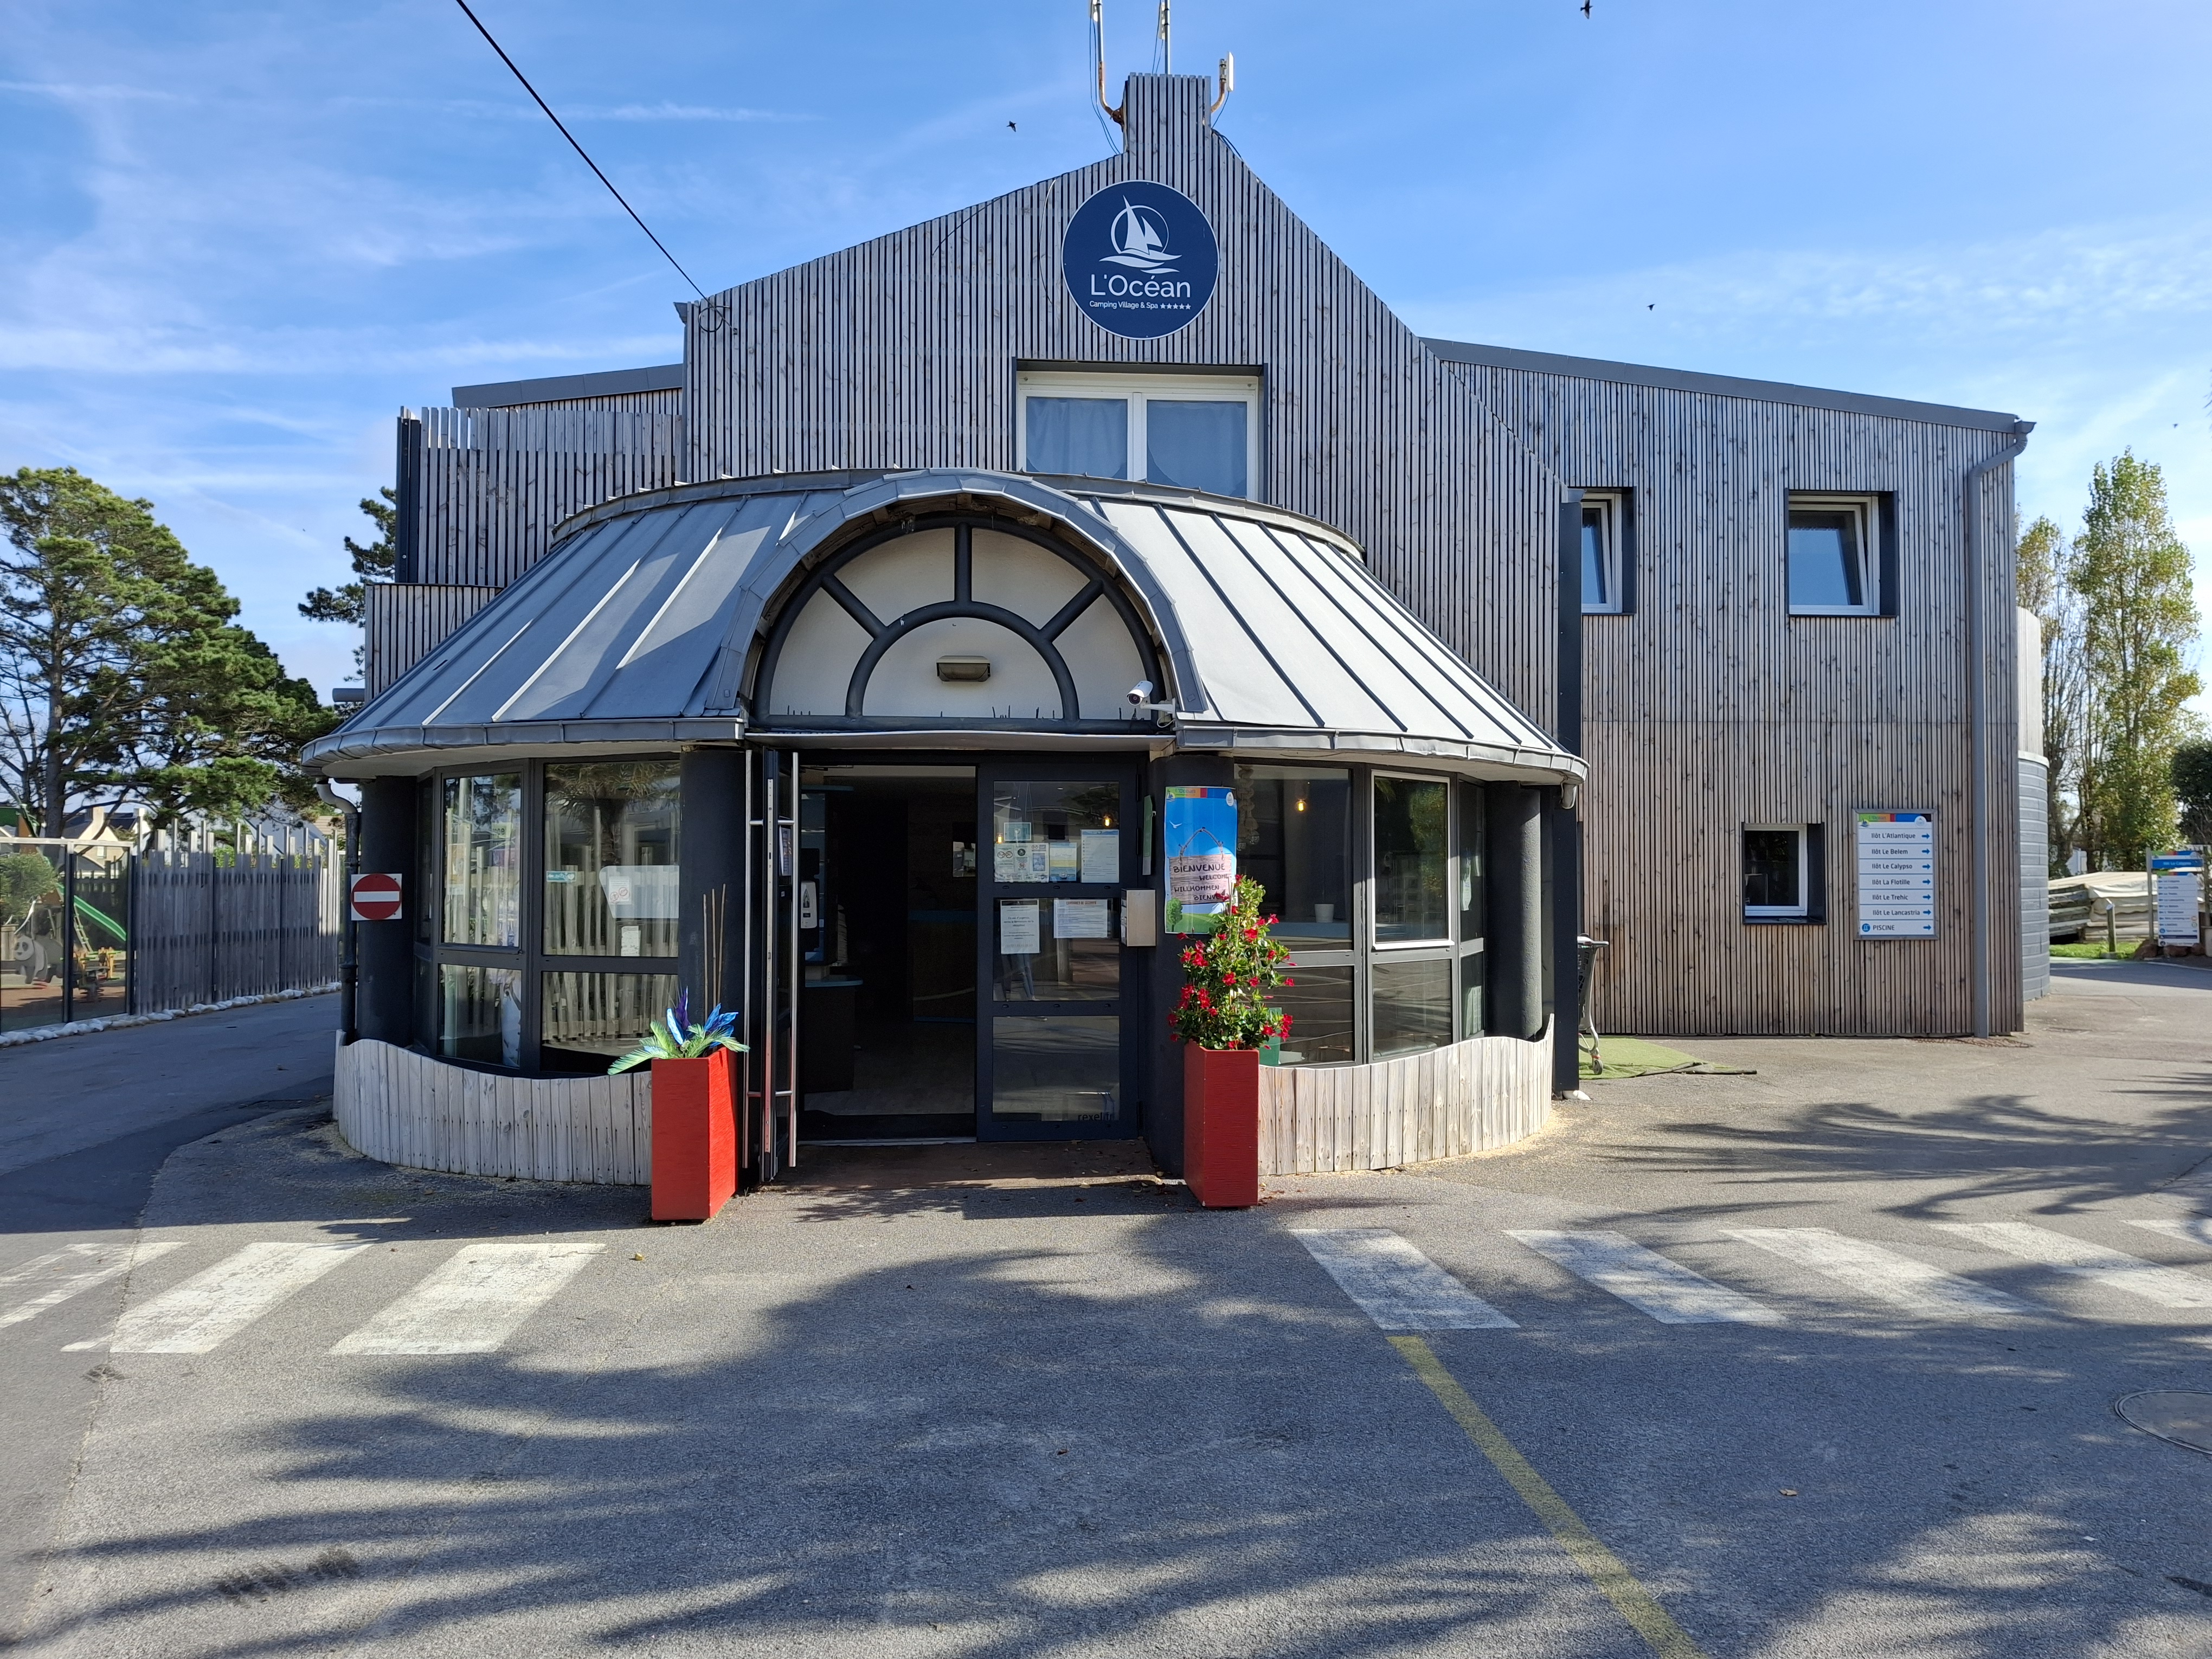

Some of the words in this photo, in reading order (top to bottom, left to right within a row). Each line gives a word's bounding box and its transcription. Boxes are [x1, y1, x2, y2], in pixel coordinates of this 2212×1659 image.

[1091, 274, 1191, 298] L'Océan
[1089, 300, 1117, 309] Camping
[1118, 301, 1139, 310] Village
[1146, 302, 1159, 310] Spa
[1174, 884, 1219, 892] WILLKOMMEN
